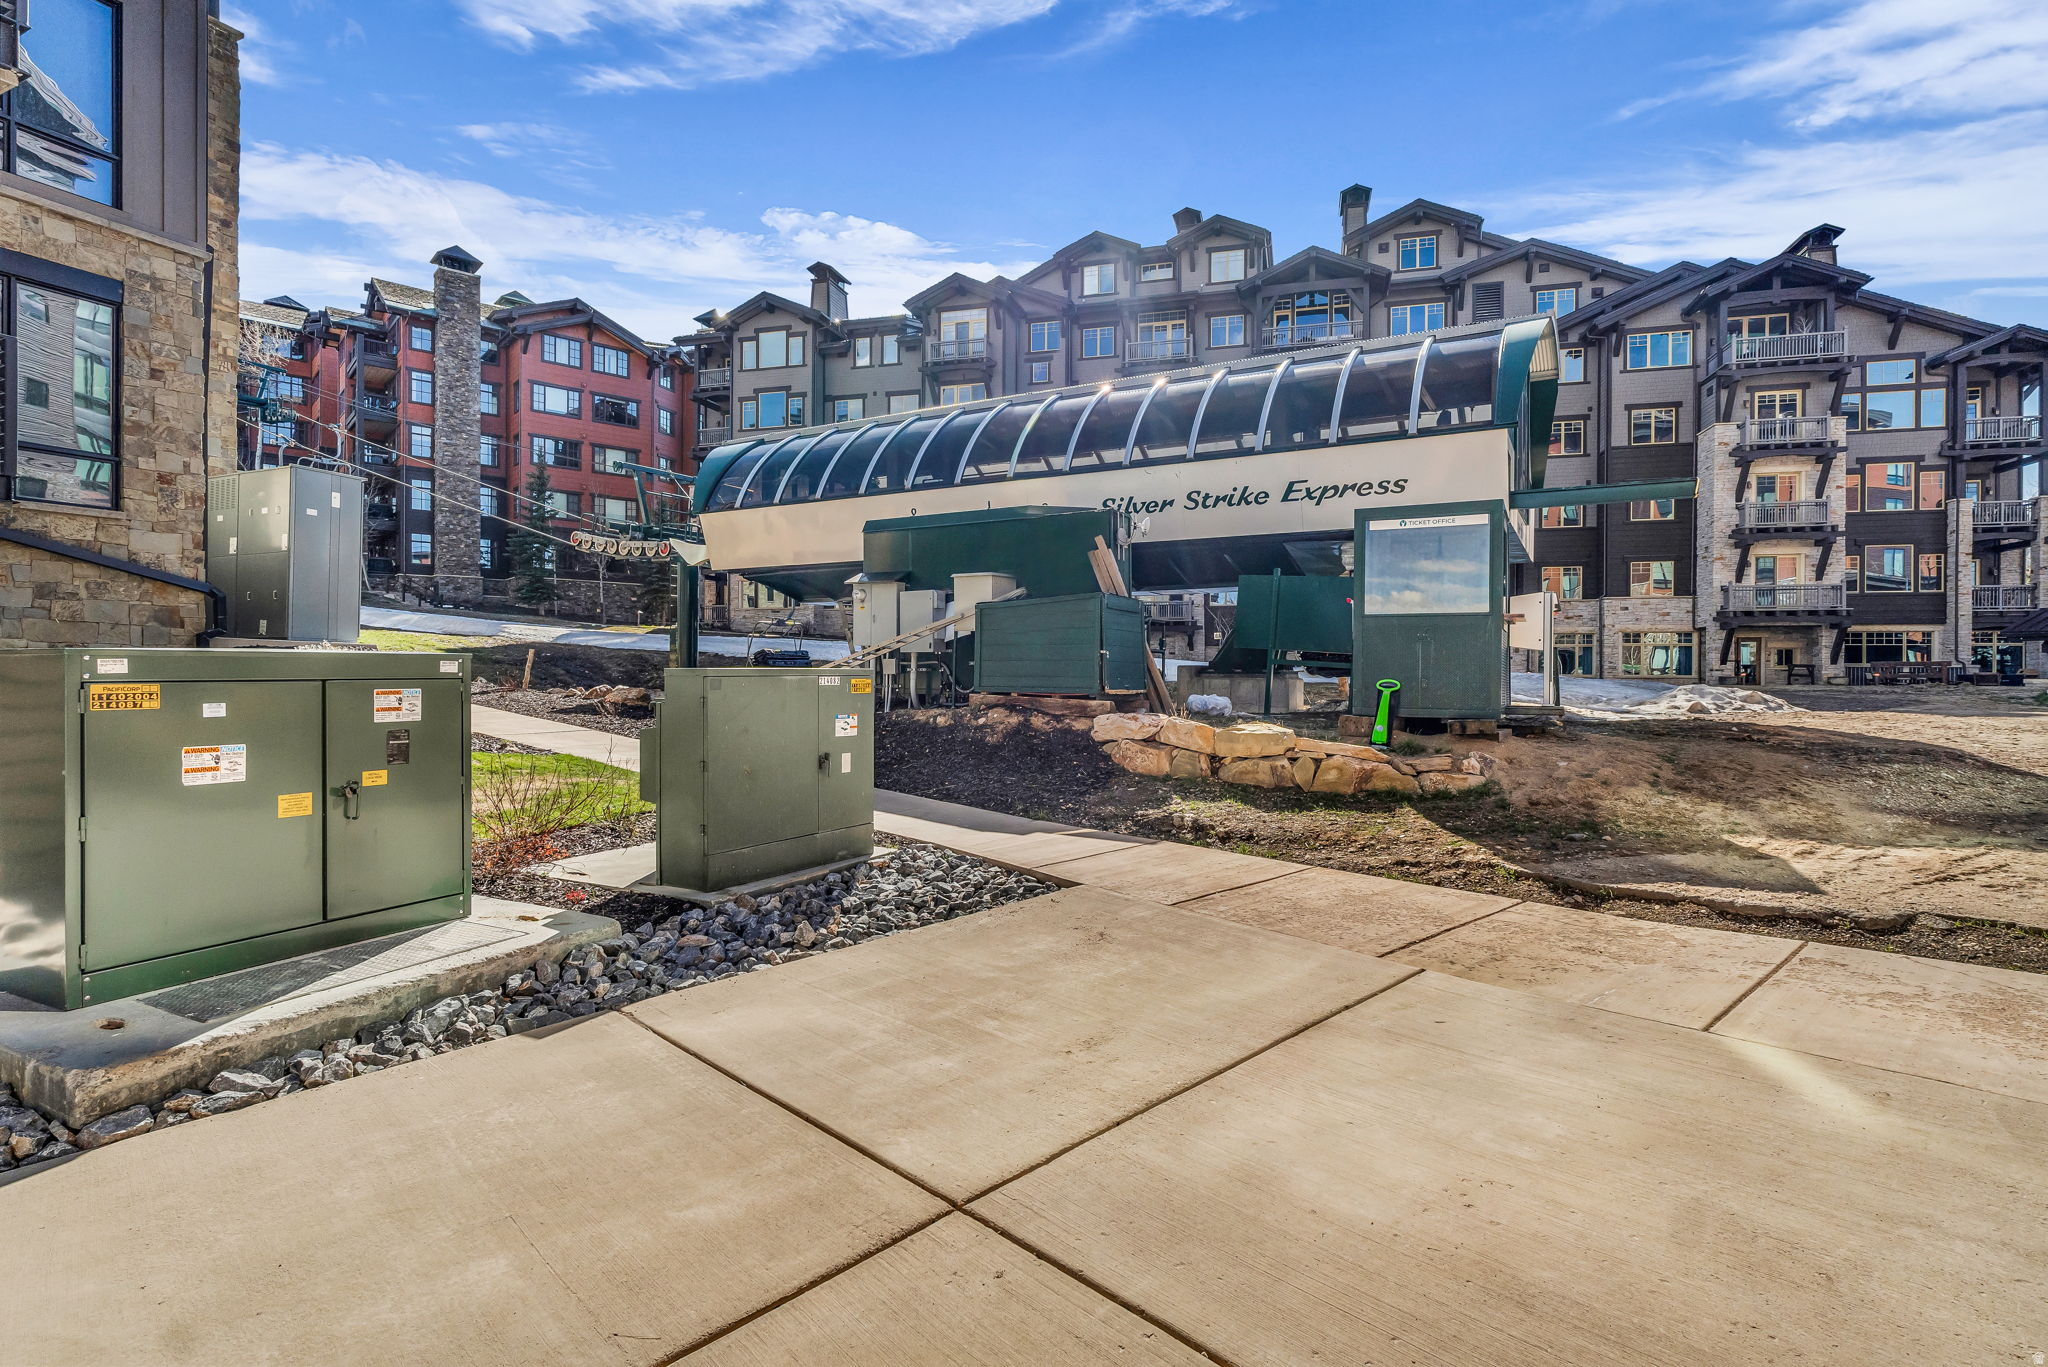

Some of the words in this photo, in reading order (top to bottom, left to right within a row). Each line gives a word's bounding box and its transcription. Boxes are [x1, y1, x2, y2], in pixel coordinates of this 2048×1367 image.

[1102, 496, 1175, 514] Silver
[1184, 486, 1270, 511] Strike
[1280, 479, 1409, 506] Express
[92, 701, 141, 709] 214087
